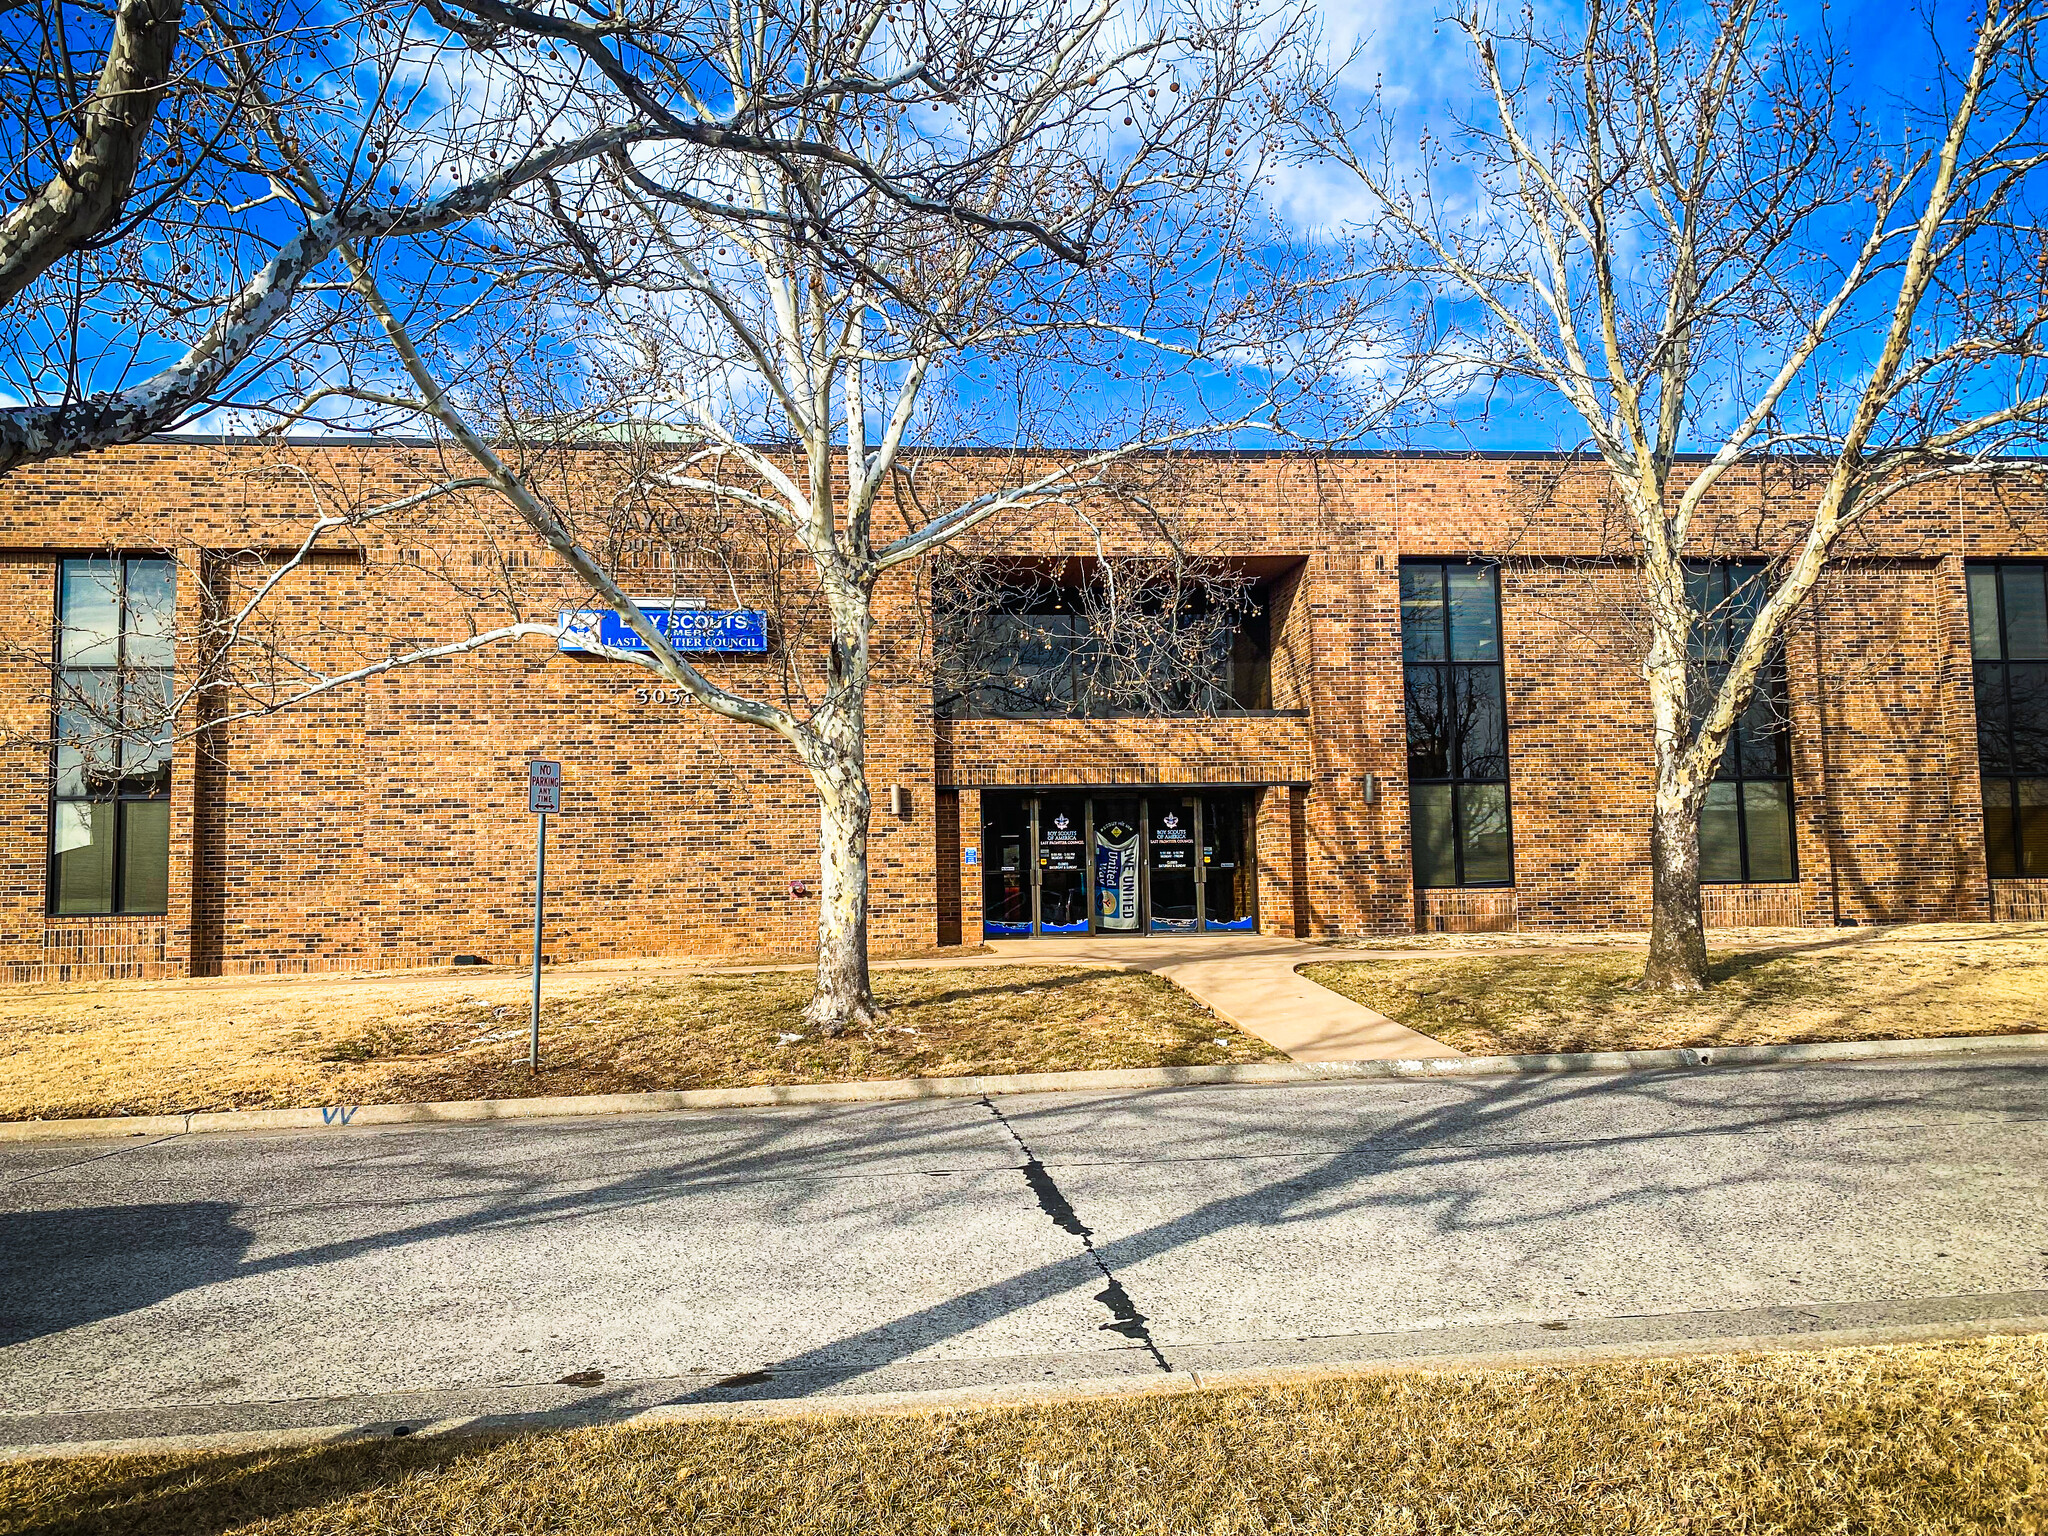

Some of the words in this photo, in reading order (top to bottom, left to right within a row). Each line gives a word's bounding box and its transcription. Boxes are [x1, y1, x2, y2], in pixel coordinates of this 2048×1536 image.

[667, 614, 748, 629] SCOUTS
[607, 637, 639, 647] LAST
[705, 637, 759, 647] COUNCIL
[539, 764, 552, 775] NO
[532, 776, 559, 787] PARKING
[537, 795, 552, 803] TIME
[1123, 846, 1135, 872] LIVE
[1097, 862, 1107, 885] Way
[1106, 851, 1119, 887] United
[1122, 876, 1135, 919] UNITED
